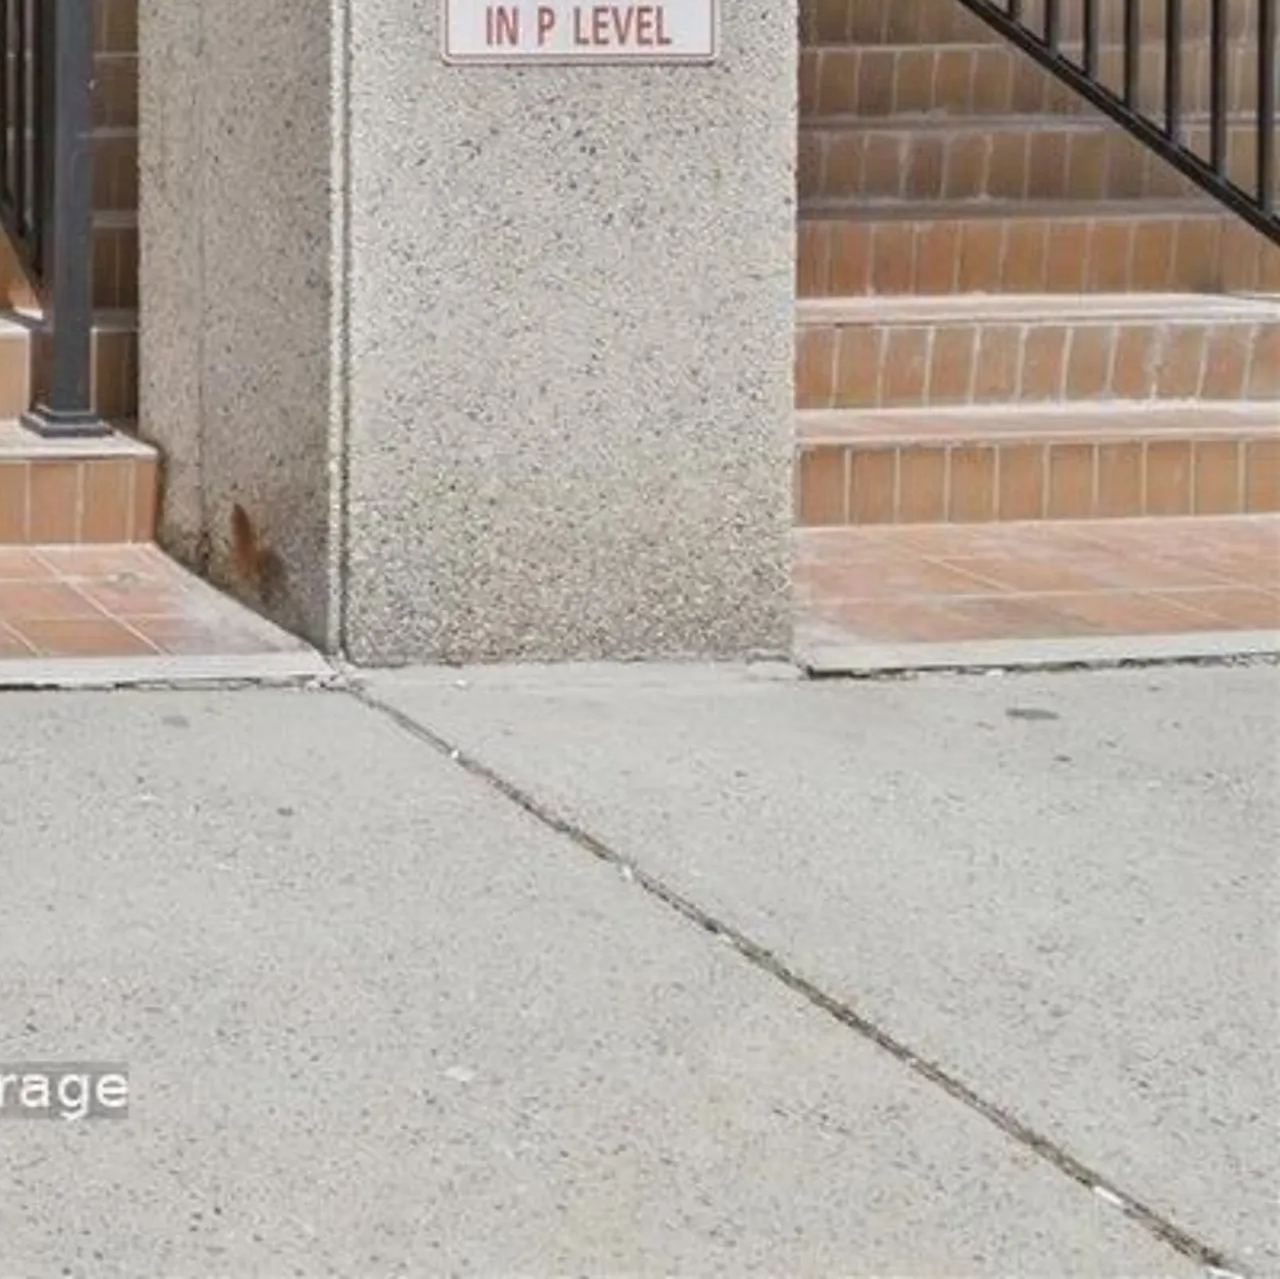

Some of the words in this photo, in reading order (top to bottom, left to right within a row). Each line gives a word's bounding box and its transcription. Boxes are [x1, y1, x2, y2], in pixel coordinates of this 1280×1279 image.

[486, 6, 520, 45] IN
[537, 7, 556, 45] P
[573, 7, 673, 45] LEVEL
